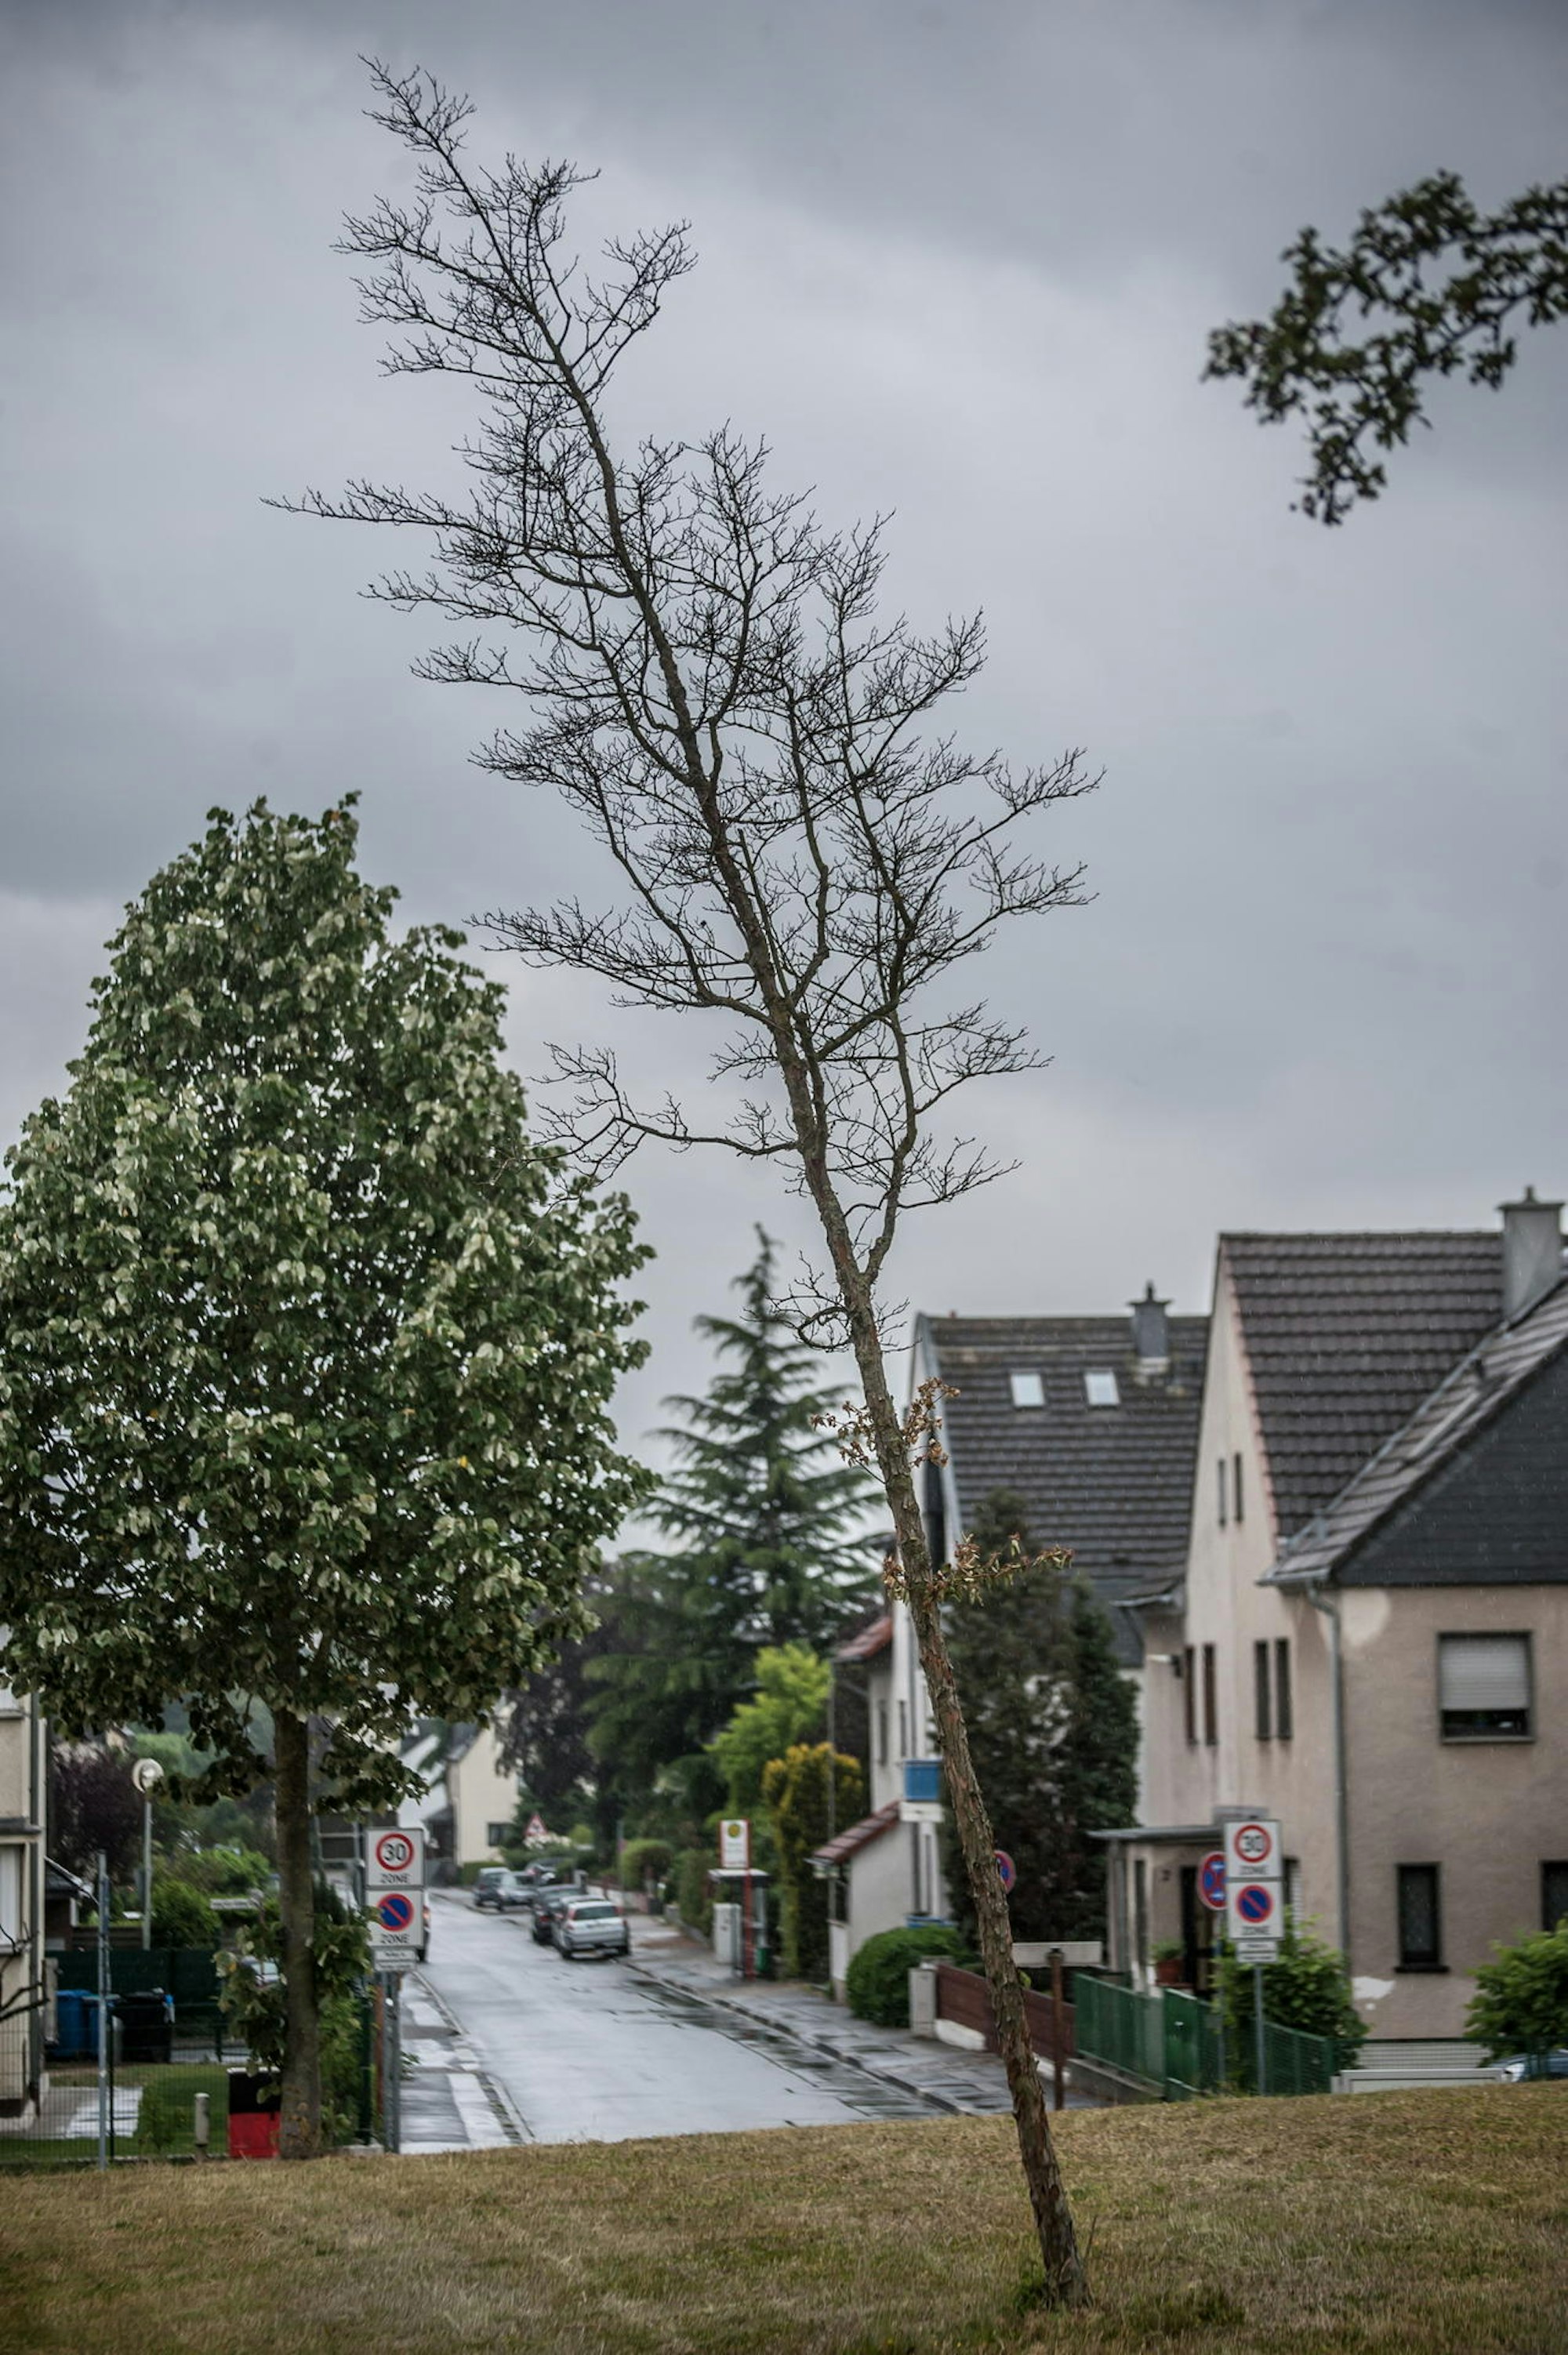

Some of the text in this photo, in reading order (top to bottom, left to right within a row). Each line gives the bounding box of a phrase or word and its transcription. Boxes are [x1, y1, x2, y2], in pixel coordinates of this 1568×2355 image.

[1242, 1835, 1265, 1852] 30
[383, 1843, 406, 1861] 30
[380, 1874, 410, 1883] ZONE
[380, 1933, 409, 1944] ZONE
